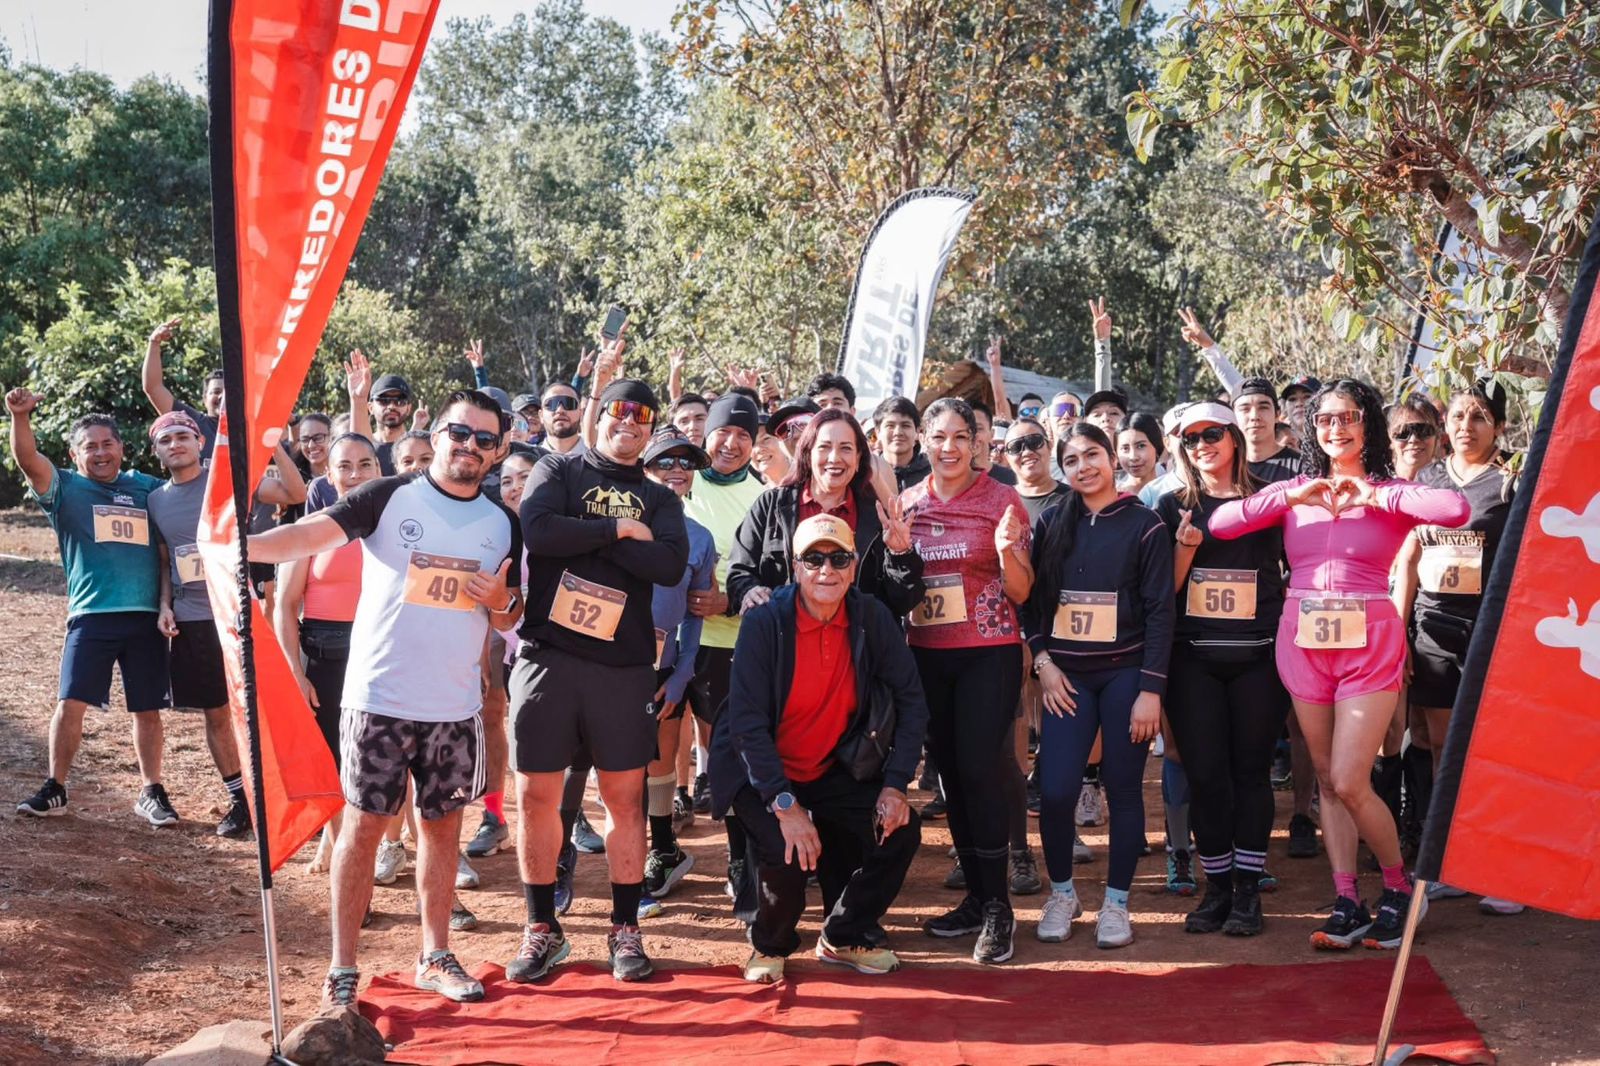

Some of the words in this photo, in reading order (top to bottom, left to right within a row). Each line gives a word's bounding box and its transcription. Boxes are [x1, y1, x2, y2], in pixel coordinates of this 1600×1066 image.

[585, 500, 607, 517] TRAIL
[608, 505, 642, 520] RUNNER
[111, 519, 134, 539] 90
[1438, 535, 1486, 547] NAYARIT
[921, 547, 968, 562] NAYARIT
[427, 575, 459, 603] 49
[1205, 588, 1235, 613] 56
[569, 598, 602, 630] 52
[922, 594, 945, 620] 32
[1070, 610, 1094, 635] 57
[1315, 617, 1342, 643] 31
